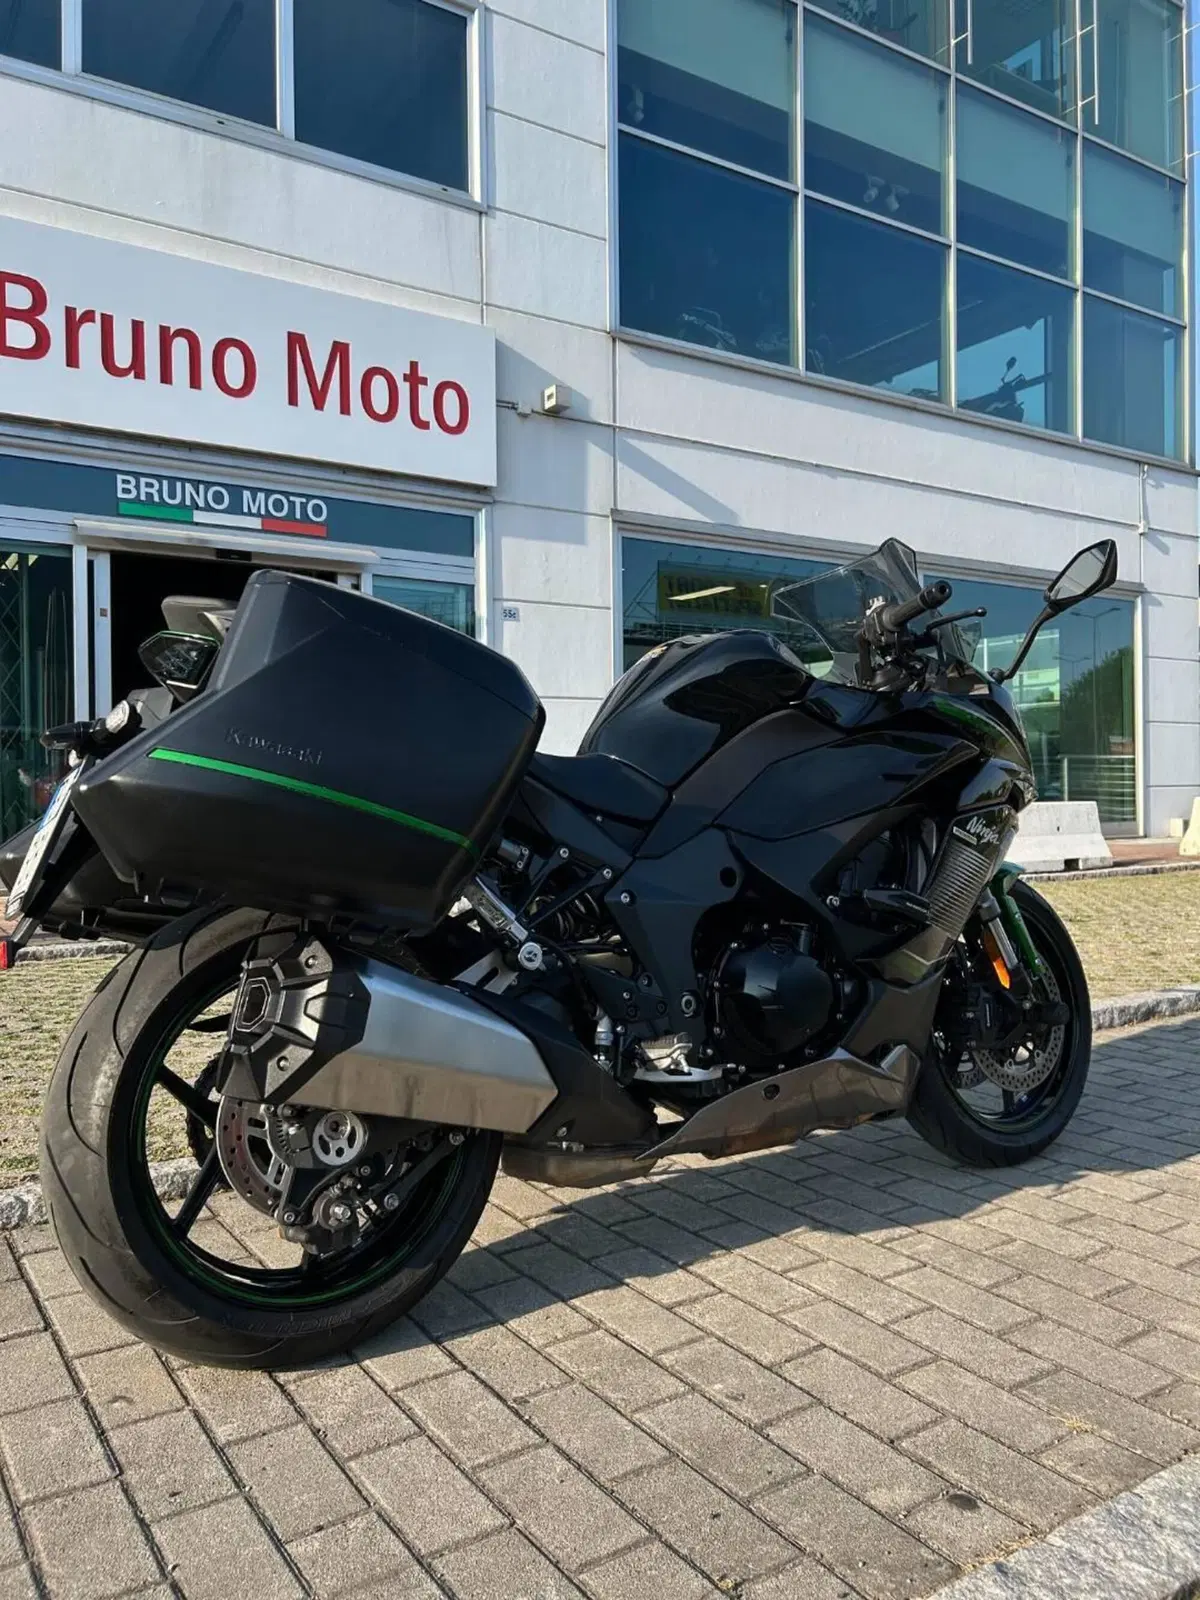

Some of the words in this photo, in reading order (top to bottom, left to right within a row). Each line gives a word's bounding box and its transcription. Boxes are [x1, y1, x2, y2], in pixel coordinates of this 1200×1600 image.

[0, 270, 258, 399] Bruno
[286, 330, 470, 436] Moto
[116, 474, 230, 510] BRUNO
[242, 490, 328, 522] MOTO
[965, 815, 1000, 845] Ninja
